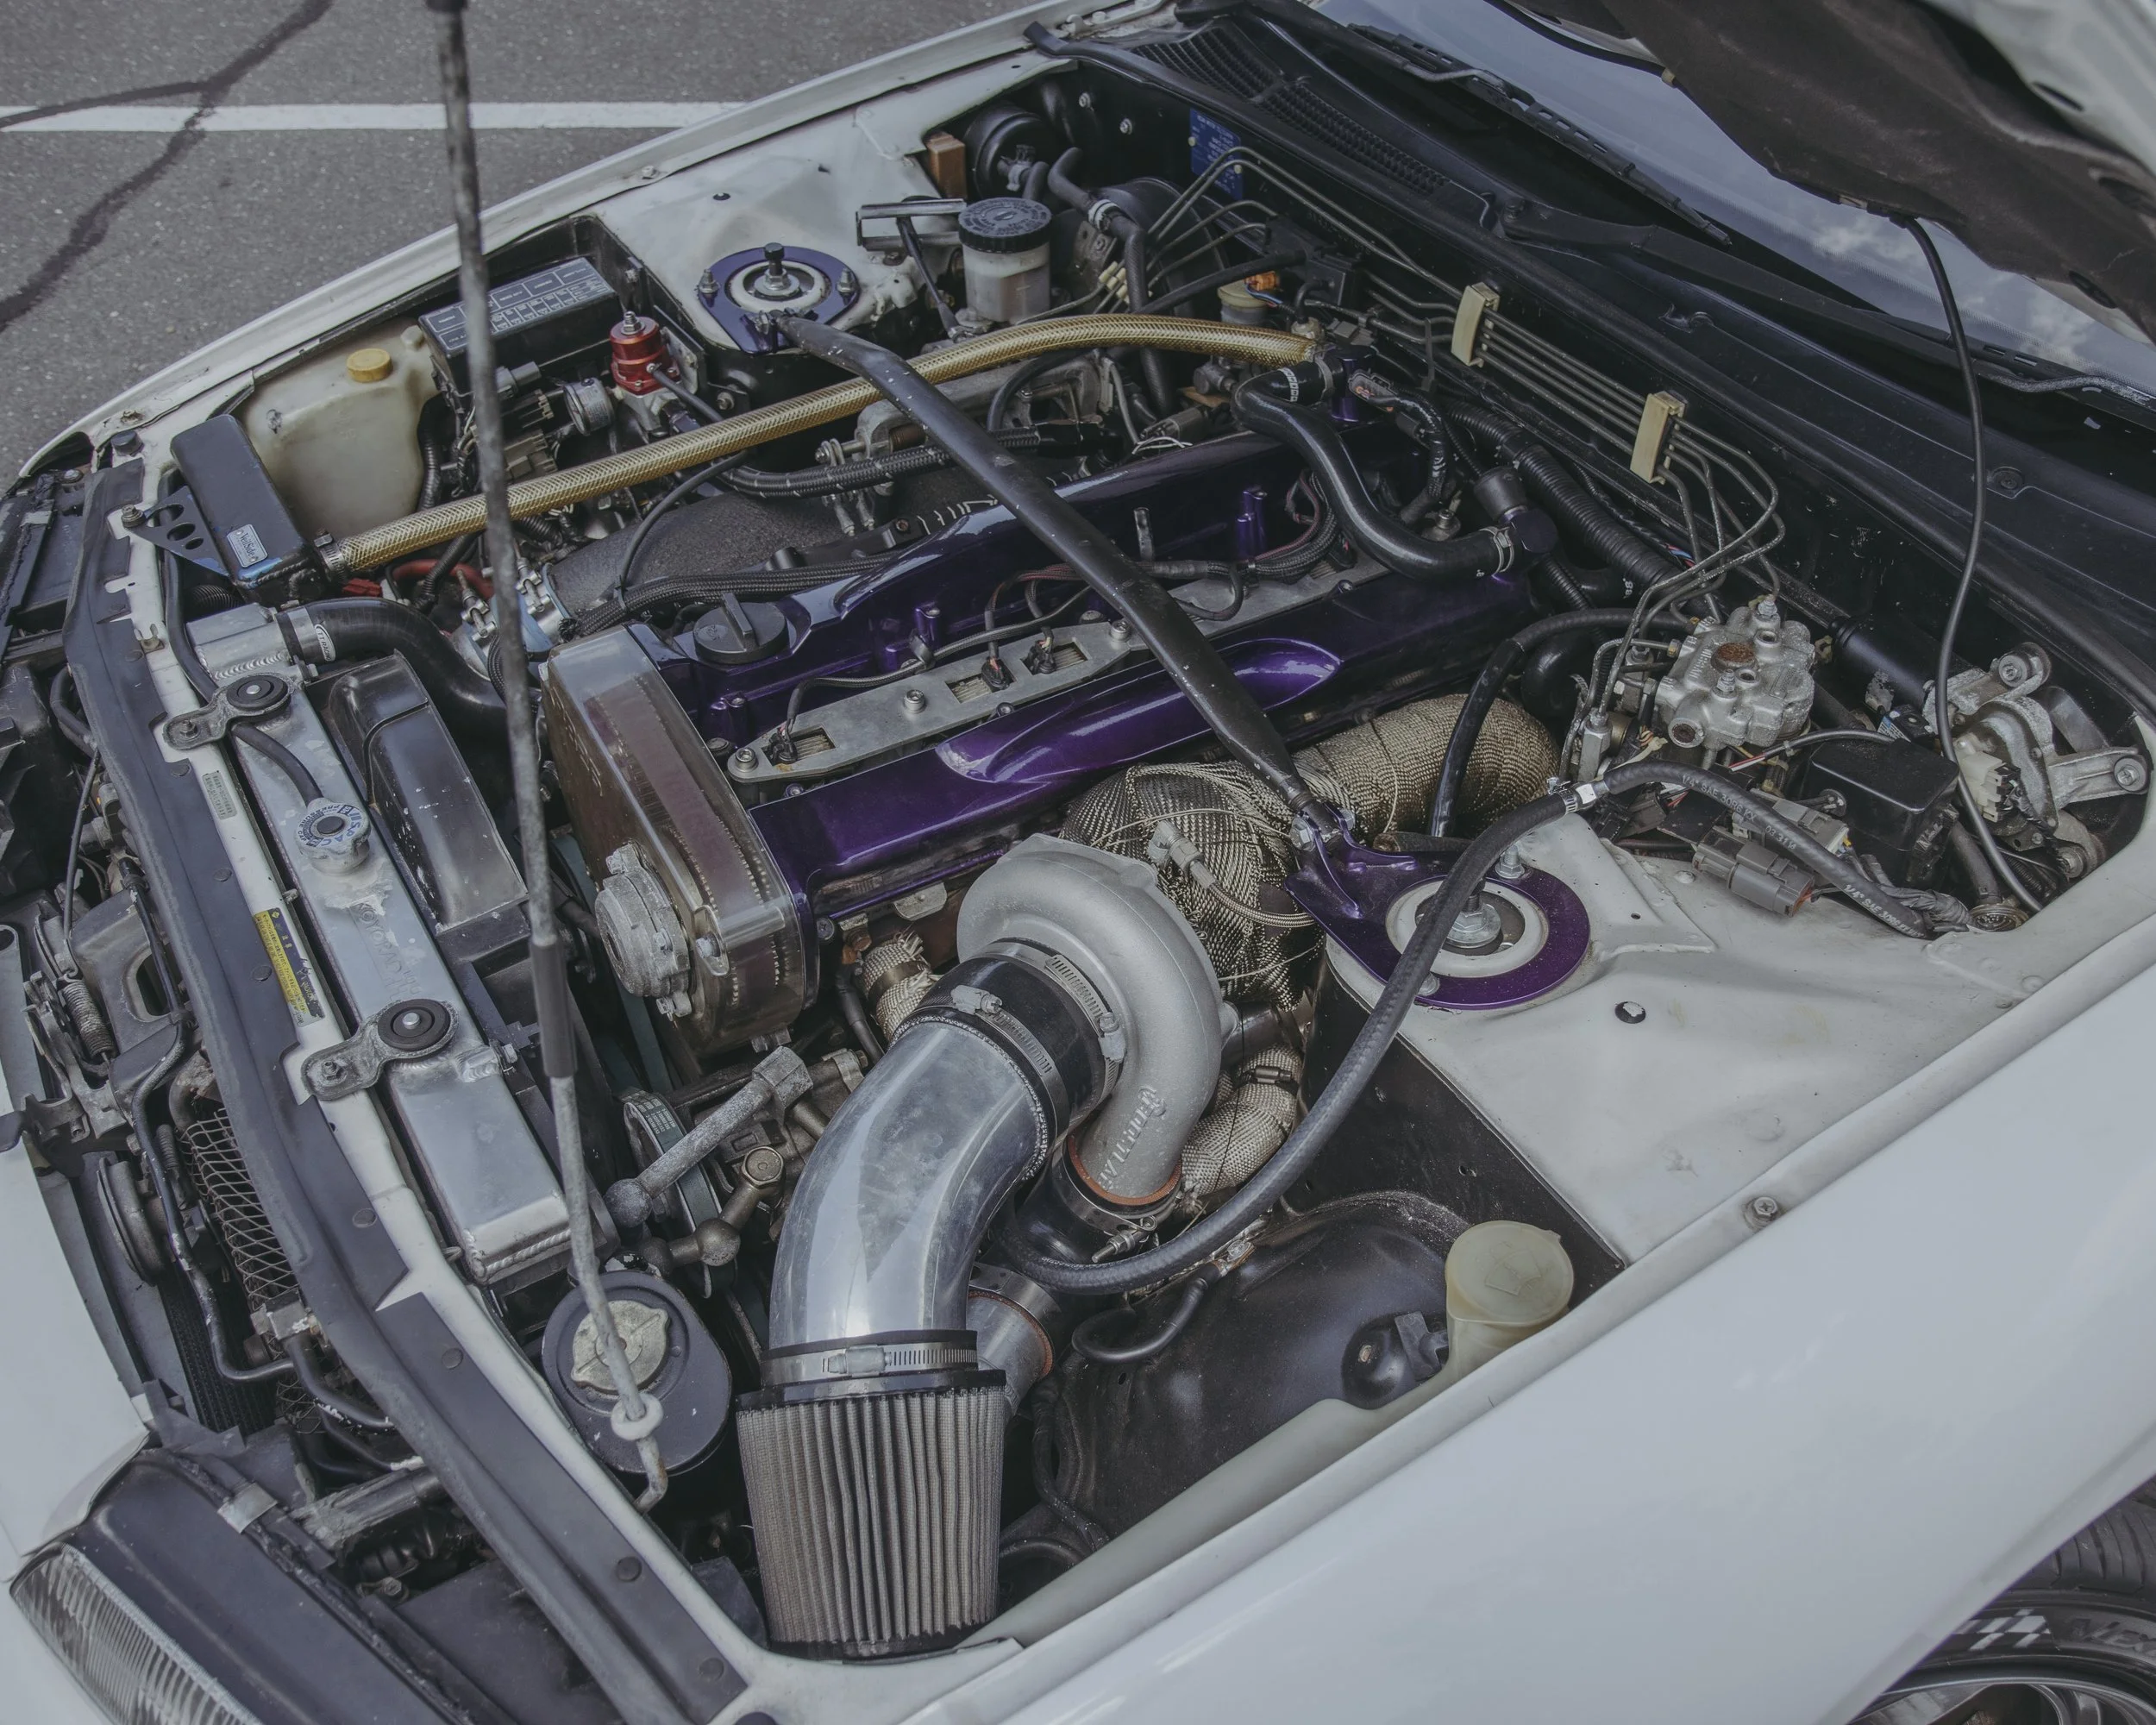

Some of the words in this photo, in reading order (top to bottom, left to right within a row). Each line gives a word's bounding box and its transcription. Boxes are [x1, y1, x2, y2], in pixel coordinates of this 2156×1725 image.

[239, 533, 258, 557] VeilSide
[1700, 783, 1720, 798] SAE
[1720, 794, 1742, 812] 30R6
[1742, 809, 1757, 823] KX
[1764, 825, 1777, 837] 03
[1777, 833, 1789, 844] 31
[1861, 897, 1883, 914] SAE
